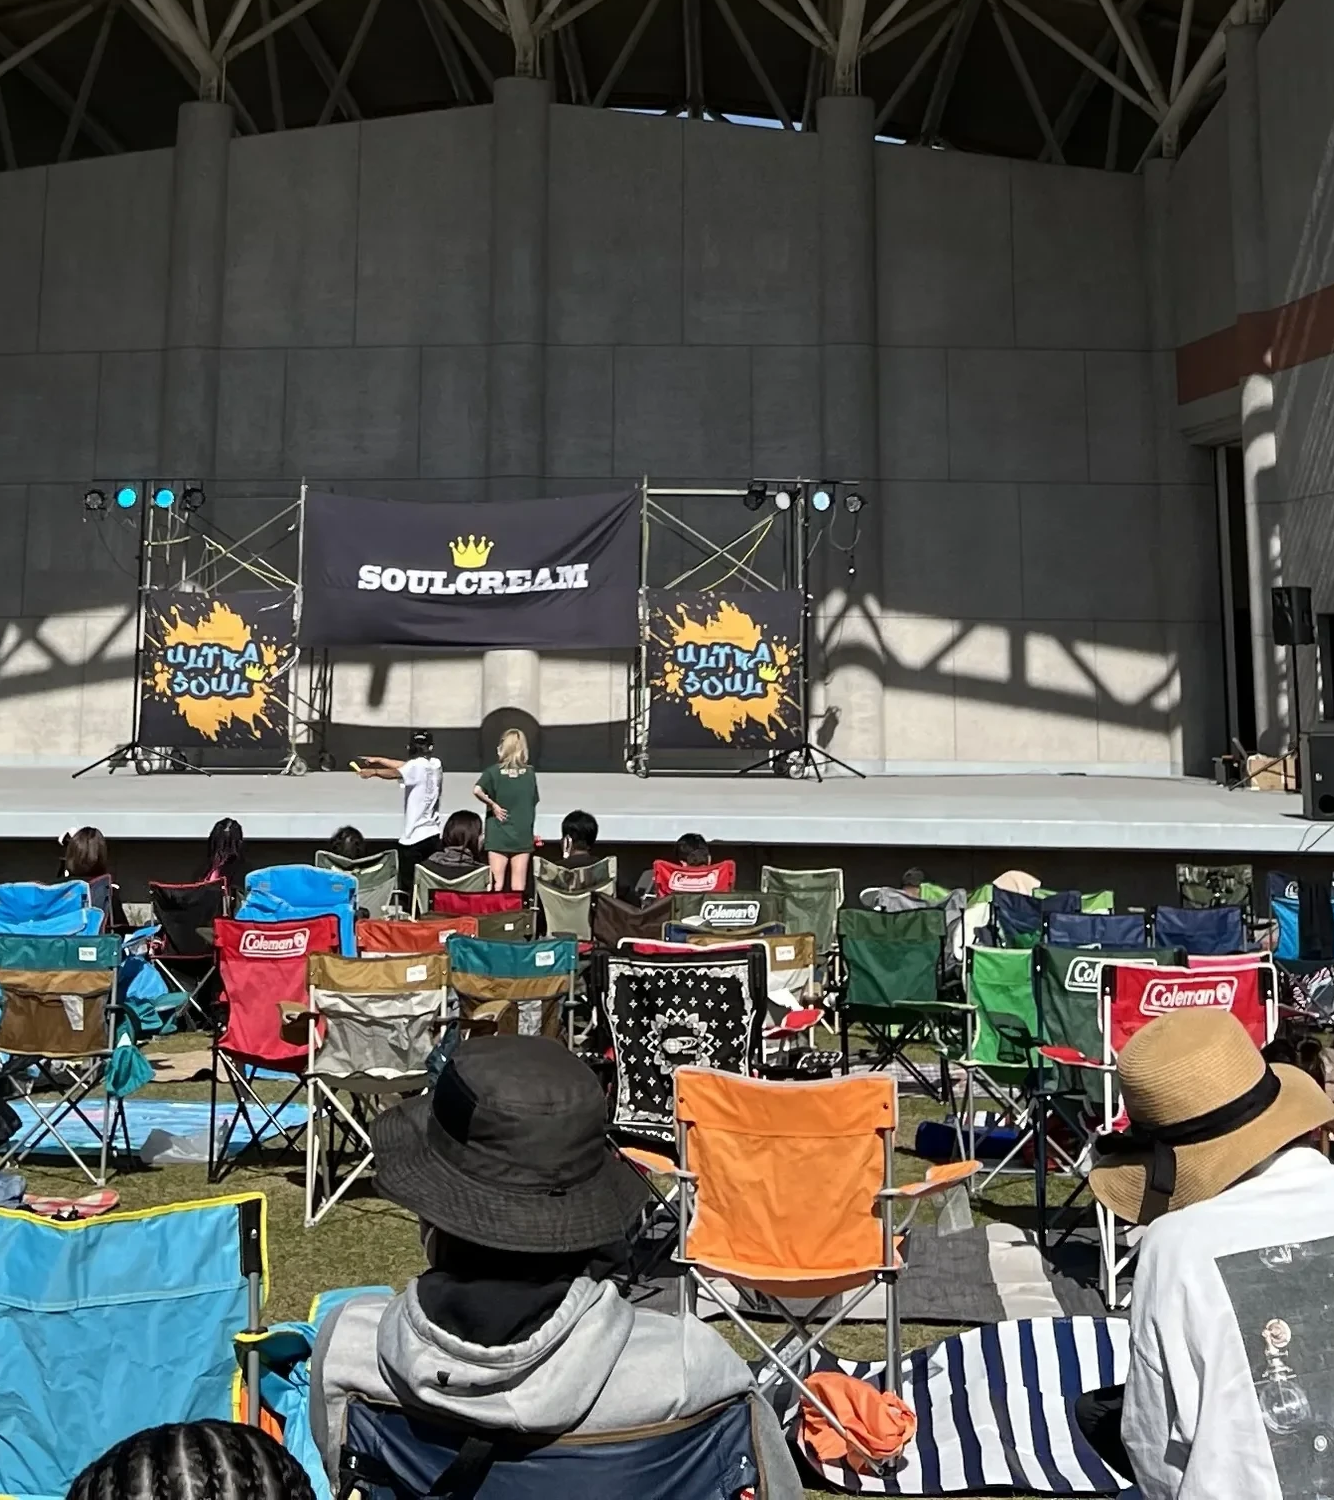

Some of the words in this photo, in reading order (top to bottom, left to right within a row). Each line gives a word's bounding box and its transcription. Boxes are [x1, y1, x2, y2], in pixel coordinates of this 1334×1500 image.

[357, 563, 589, 595] SOULCREAM
[167, 642, 260, 670] ULTRA
[677, 642, 772, 671] ULTRA
[173, 671, 250, 696] SOUL
[684, 671, 764, 696] SOUL
[704, 904, 747, 919] Coleman
[245, 933, 294, 950] Coleman
[1150, 985, 1215, 1007] Coleman
